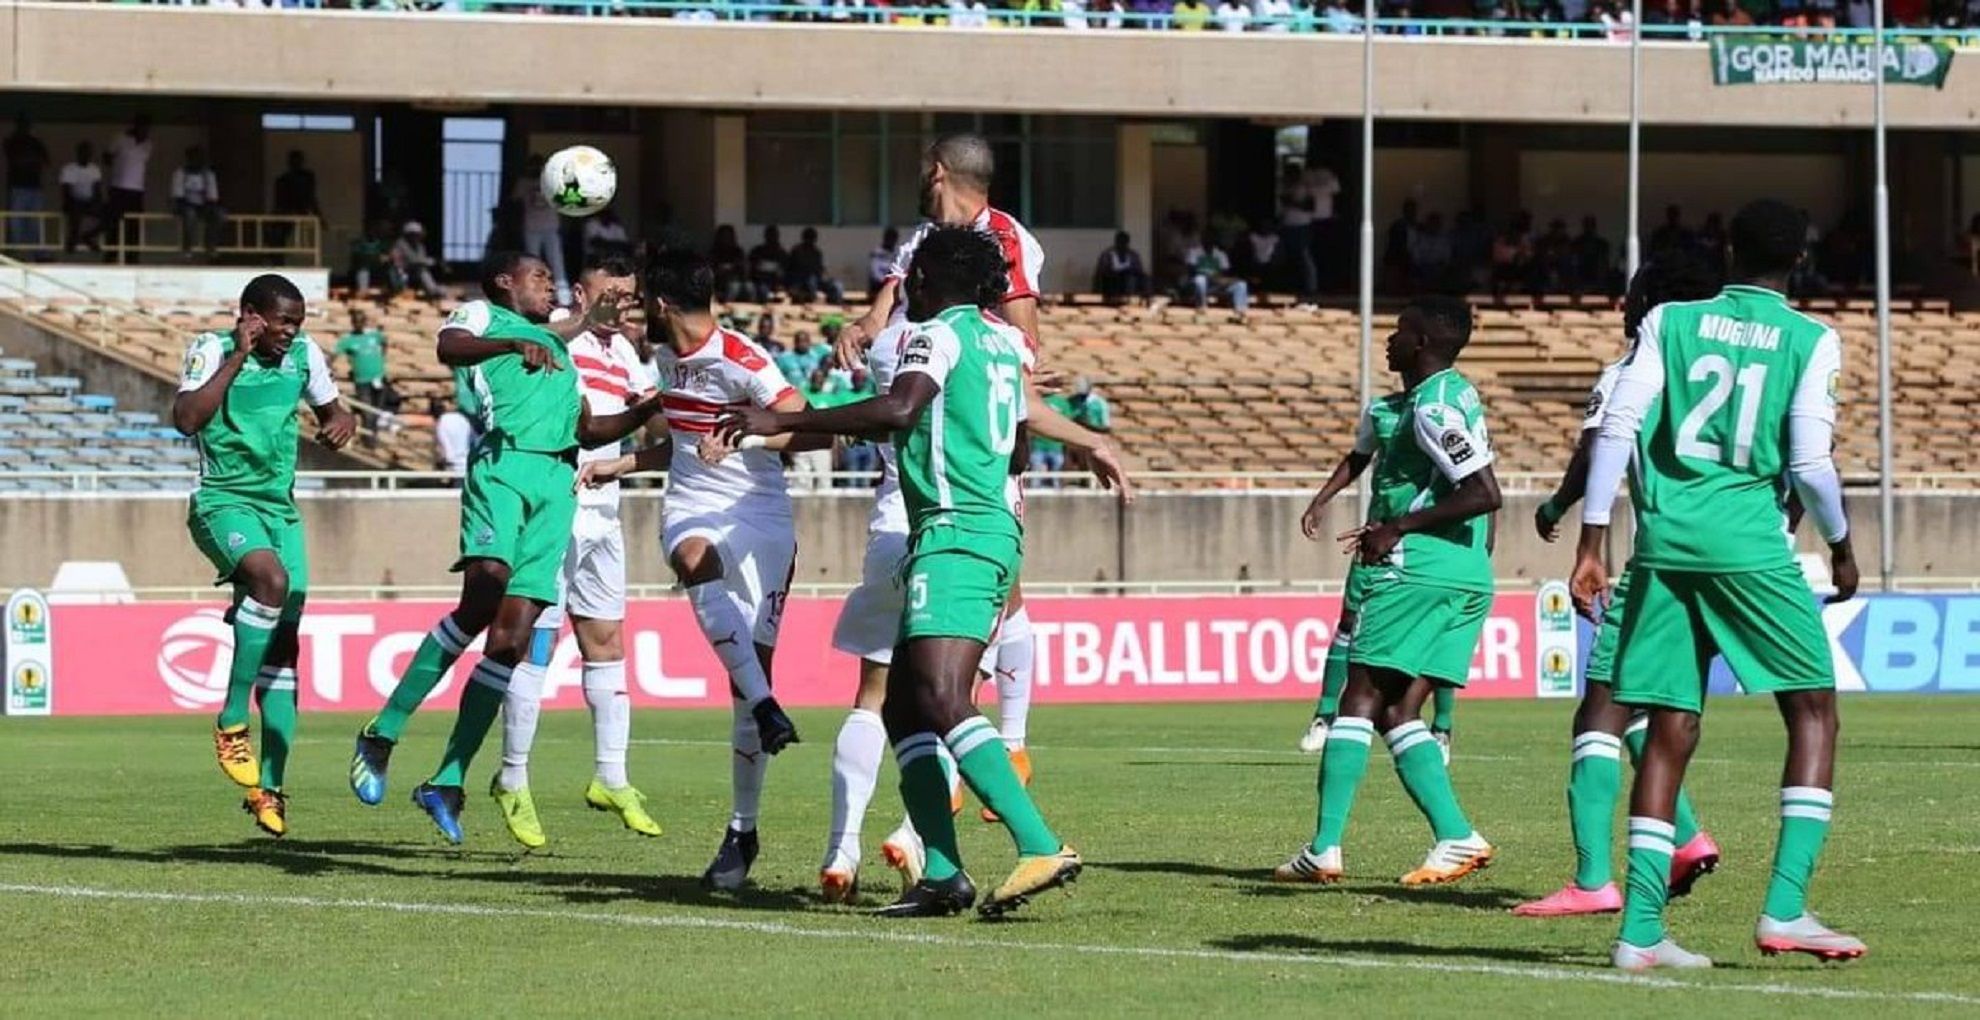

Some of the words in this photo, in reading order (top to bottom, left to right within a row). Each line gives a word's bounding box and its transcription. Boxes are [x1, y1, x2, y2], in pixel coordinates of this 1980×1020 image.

[1731, 44, 1795, 71] GOR
[1804, 43, 1900, 71] MAHA
[1698, 313, 1782, 351] MUGUNA
[1675, 353, 1768, 468] 21
[298, 614, 708, 703] TOAL
